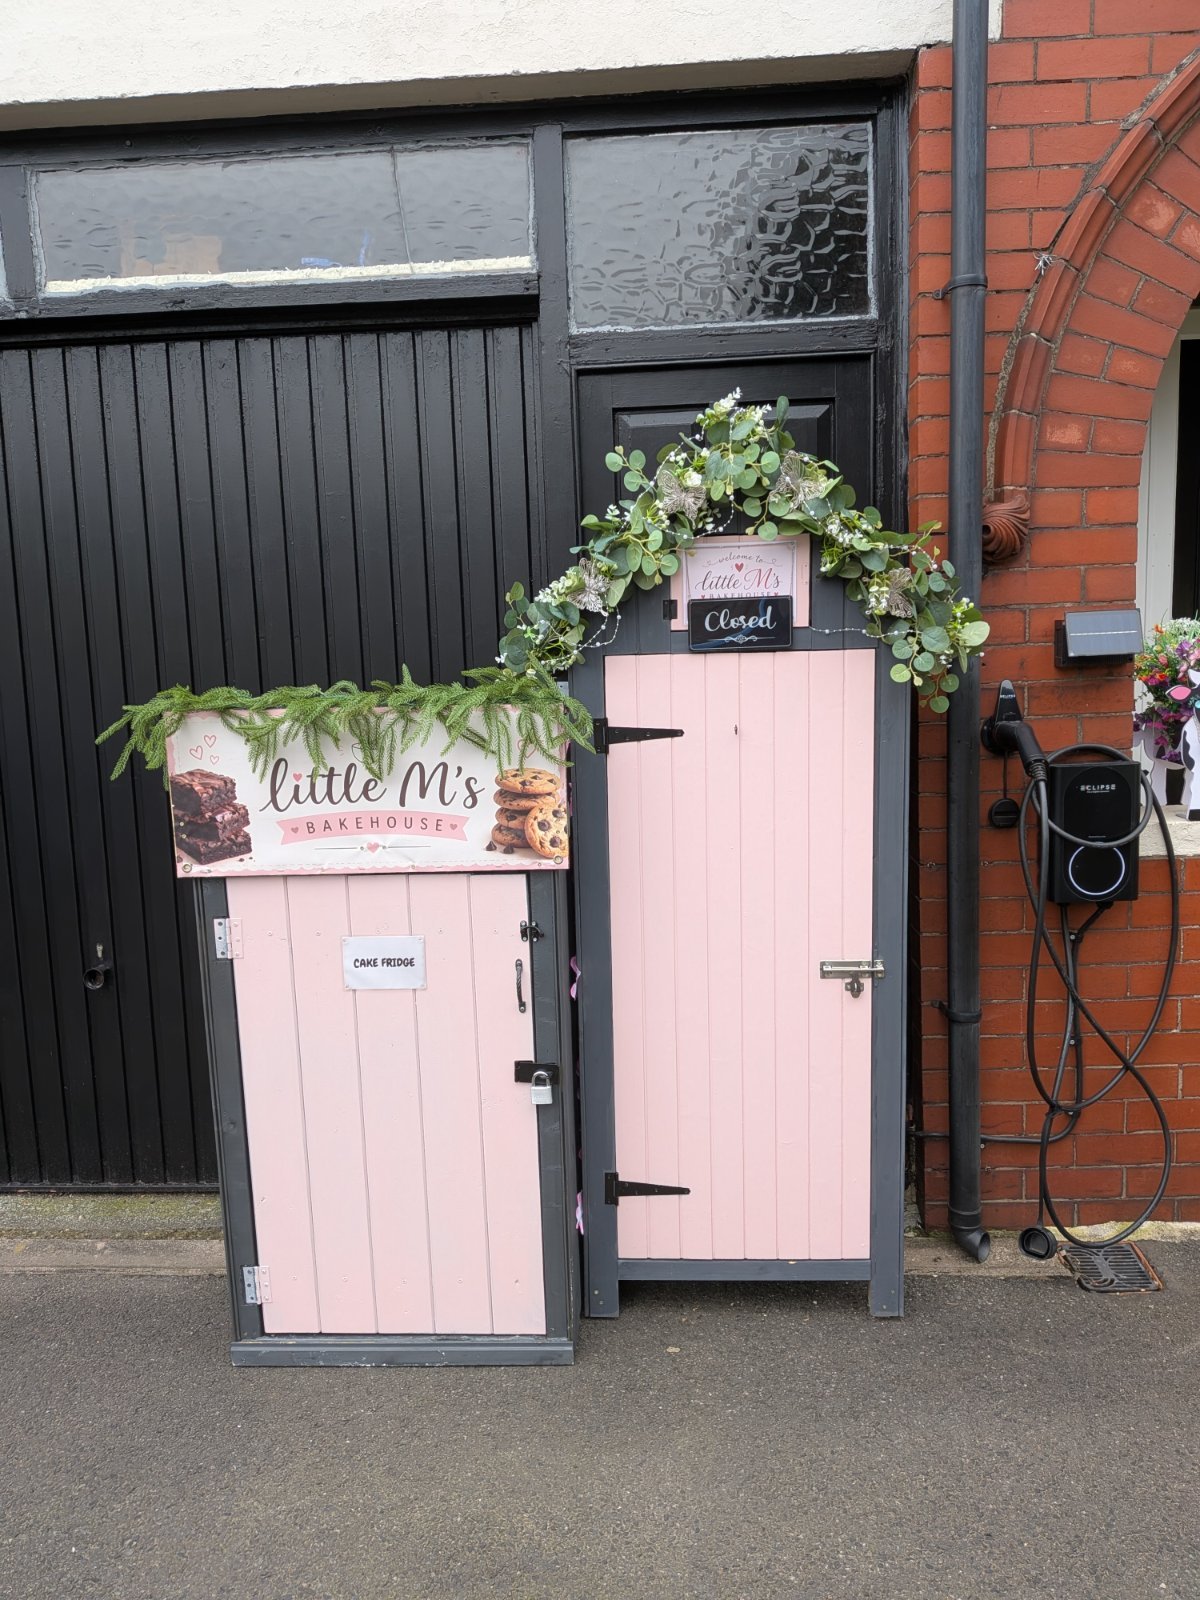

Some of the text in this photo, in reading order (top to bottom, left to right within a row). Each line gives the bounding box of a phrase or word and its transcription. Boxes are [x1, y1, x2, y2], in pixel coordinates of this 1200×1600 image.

[718, 552, 754, 562] welcome
[694, 567, 781, 591] little M's
[704, 605, 777, 633] Closed
[258, 757, 486, 813] little M's
[1080, 783, 1116, 791] ECLIPSE
[305, 815, 445, 835] BAKEHOUSE
[353, 957, 416, 969] CAKE FRIDGE
